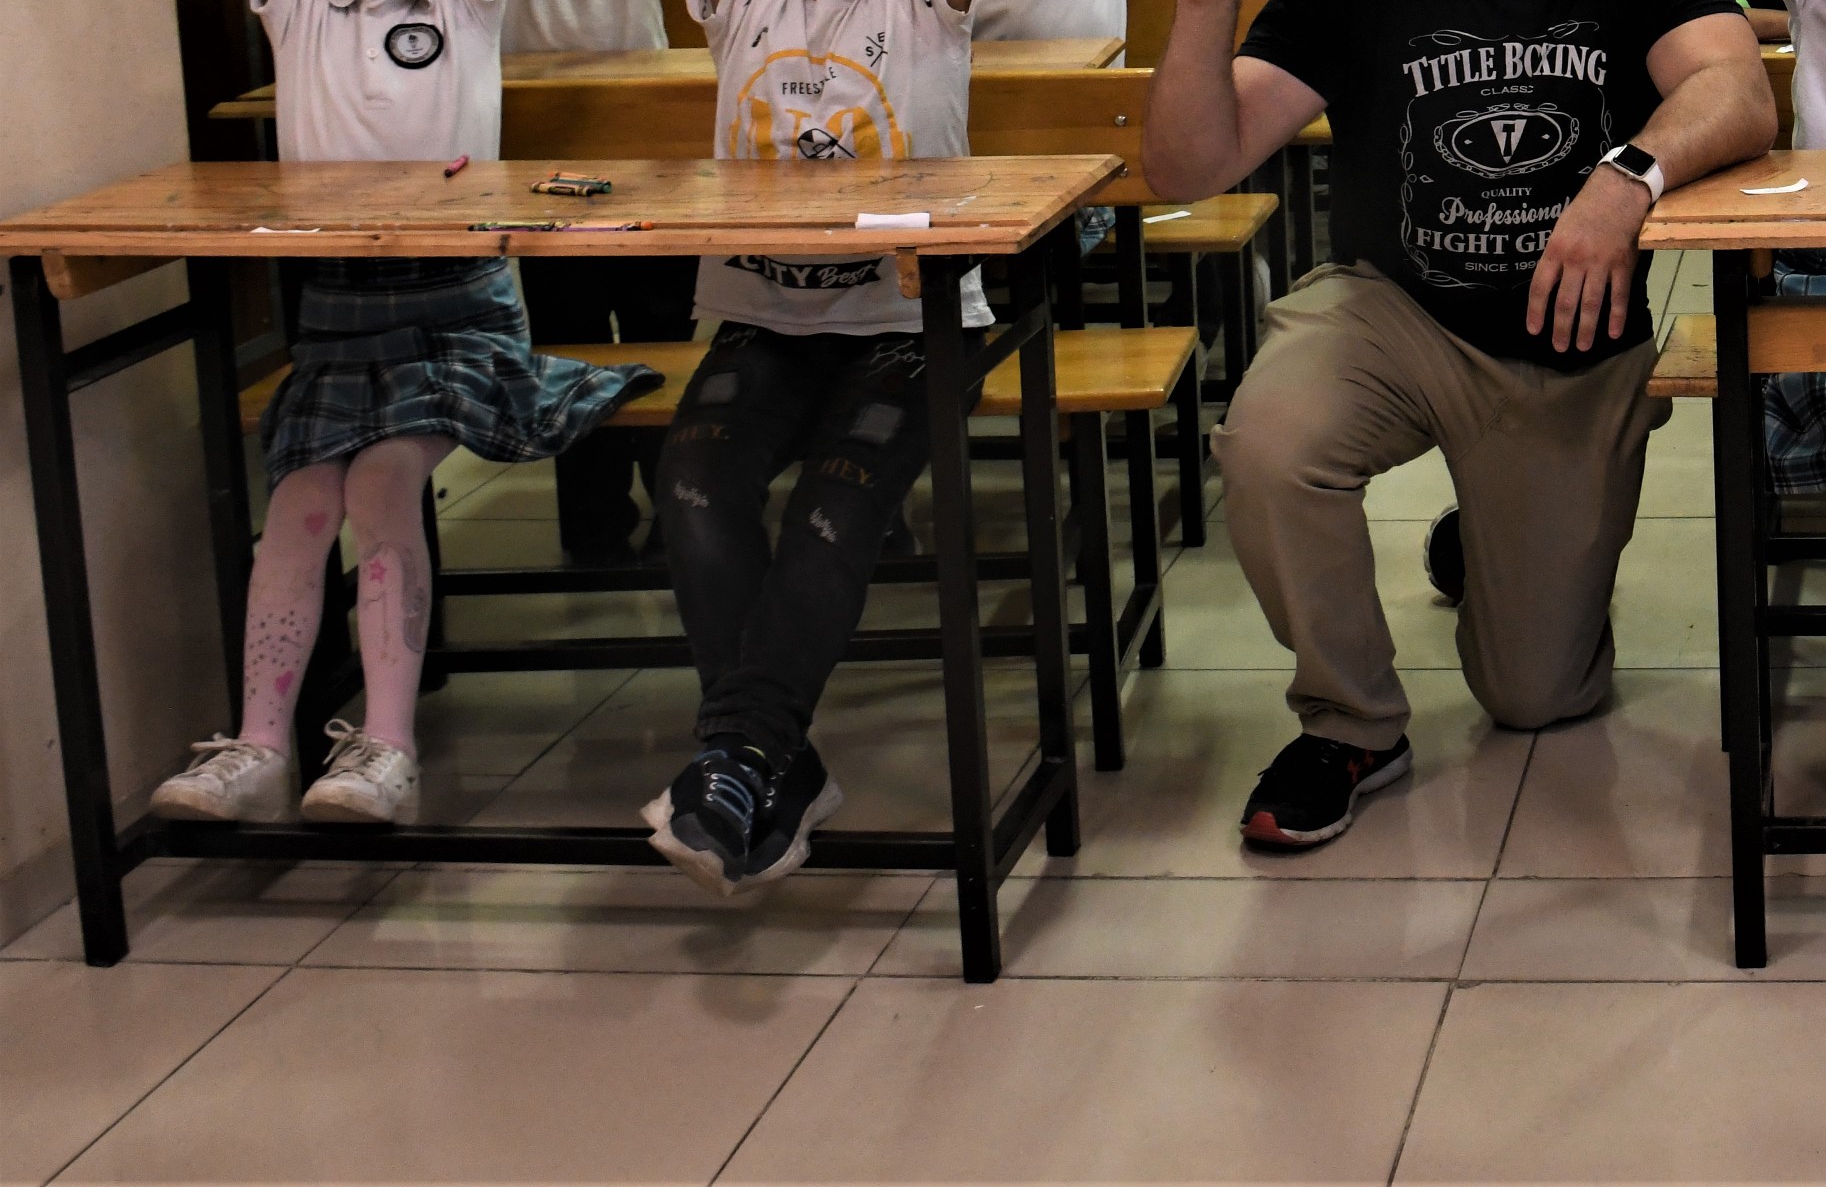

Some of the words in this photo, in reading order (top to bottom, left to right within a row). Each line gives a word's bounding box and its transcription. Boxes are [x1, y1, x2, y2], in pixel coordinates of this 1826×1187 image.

[1403, 47, 1497, 98] TITLE
[1481, 187, 1533, 199] QUALITY
[1416, 227, 1509, 255] FIGHT
[1465, 261, 1509, 272] SINCE
[1514, 260, 1539, 271] 199
